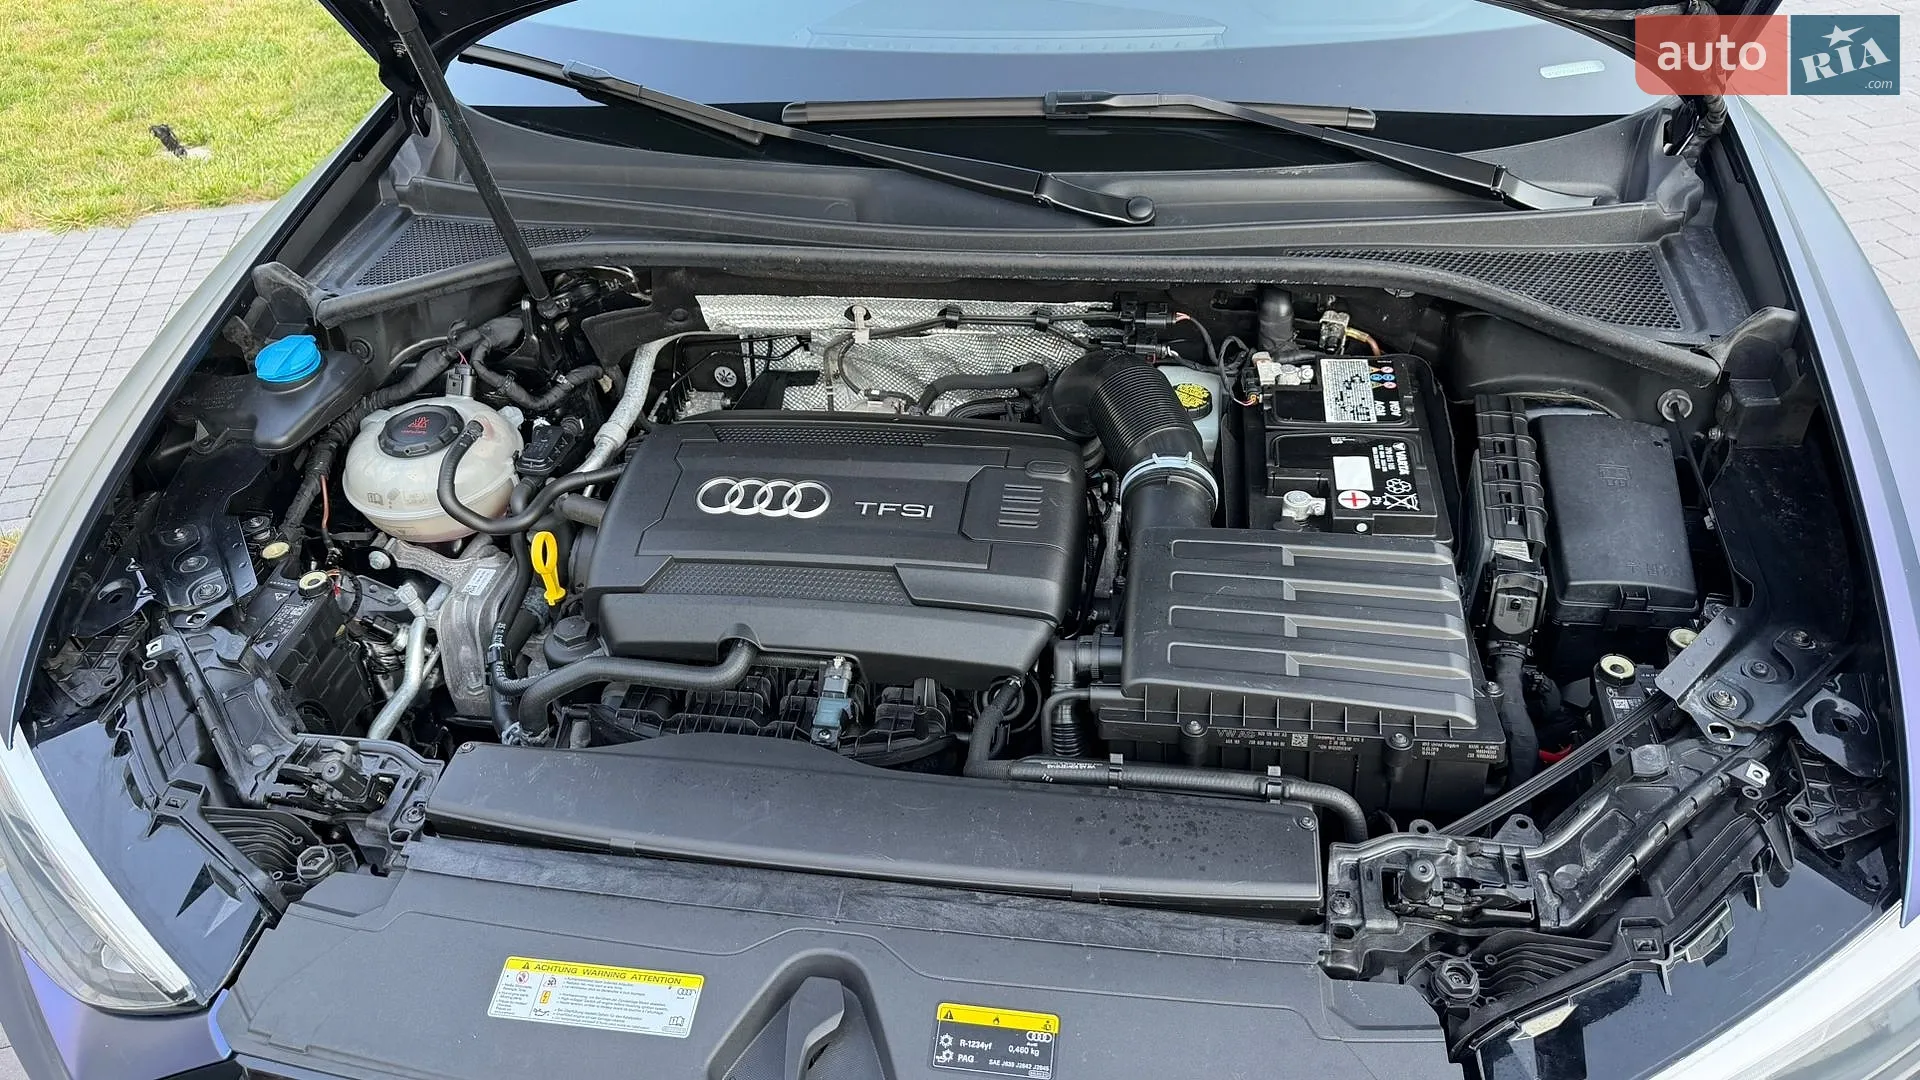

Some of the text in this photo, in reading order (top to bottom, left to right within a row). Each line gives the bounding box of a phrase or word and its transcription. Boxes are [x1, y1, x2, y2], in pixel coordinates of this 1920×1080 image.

[1395, 451, 1410, 475] VARTA
[855, 501, 935, 518] TFSI
[533, 963, 682, 985] ACHTUNG WARNING ATTENTION
[959, 1039, 993, 1050] R-1234yf
[957, 1054, 975, 1063] PAG
[1030, 1047, 1040, 1057] kg
